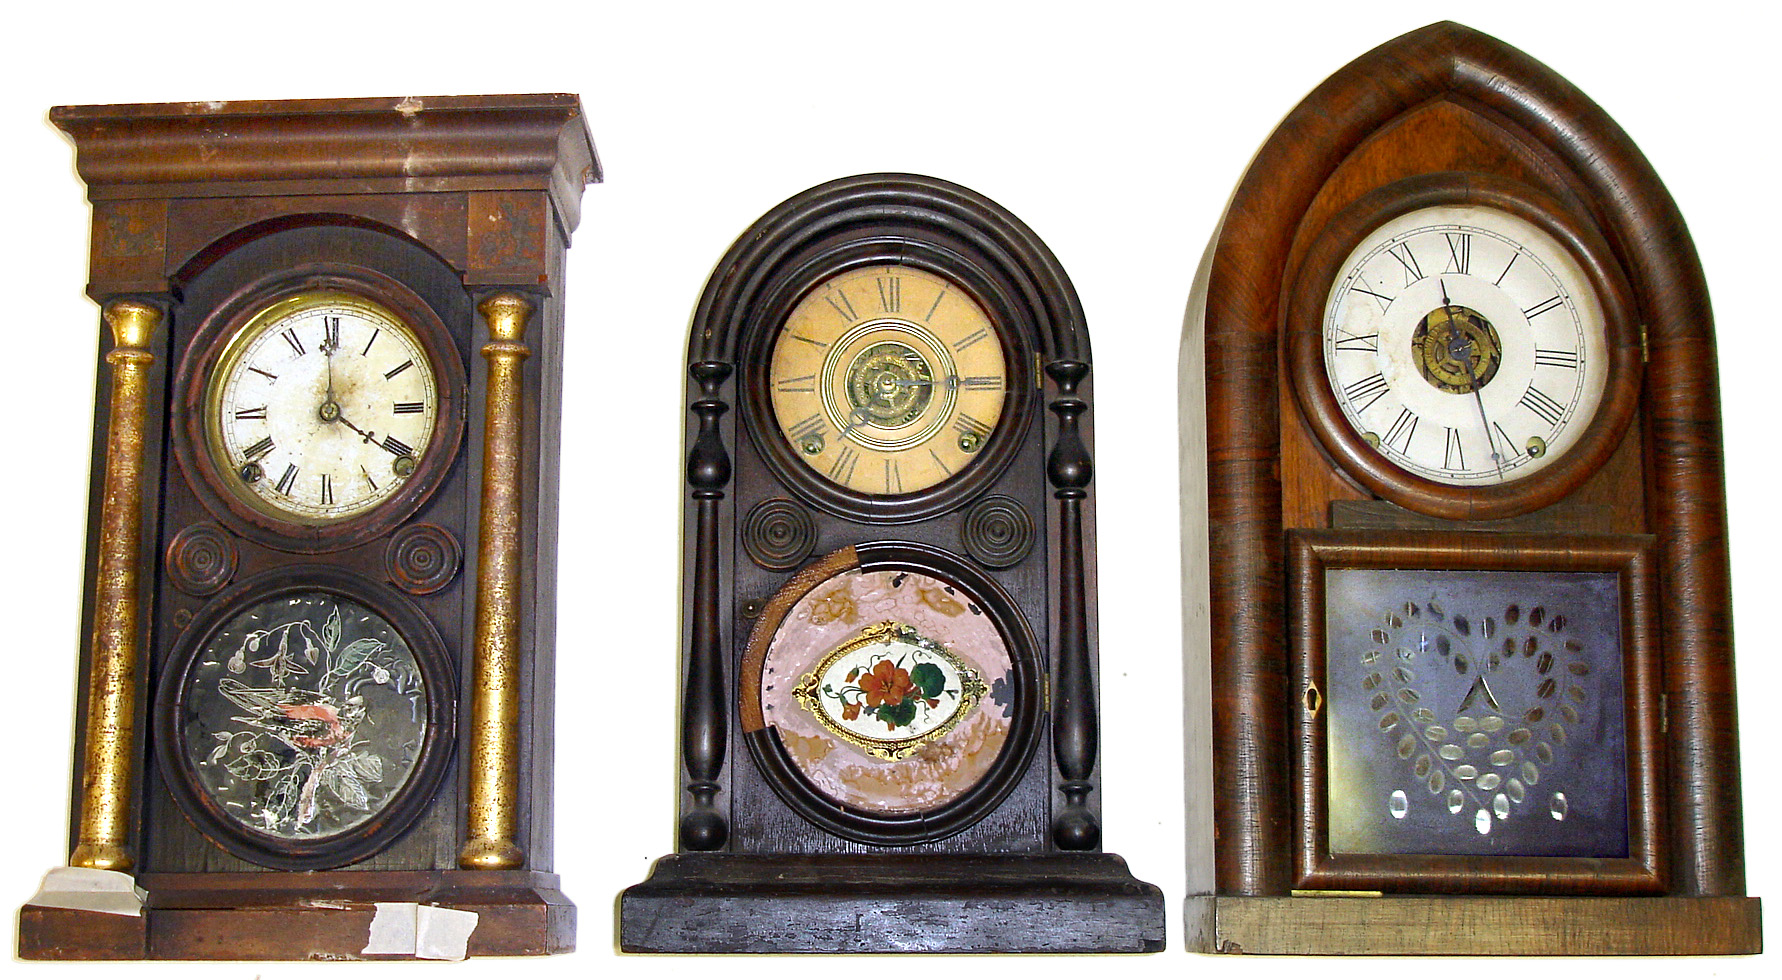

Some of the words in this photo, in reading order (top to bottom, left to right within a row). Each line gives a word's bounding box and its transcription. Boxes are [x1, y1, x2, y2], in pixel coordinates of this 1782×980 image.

[1383, 241, 1429, 289] XI
[1440, 233, 1472, 276] XII
[1492, 250, 1522, 288] I
[924, 290, 946, 324] I
[1347, 271, 1396, 315] X
[1520, 290, 1567, 326] II
[281, 327, 306, 361] XI
[321, 315, 341, 350] XII
[361, 327, 381, 357] I
[953, 327, 988, 353] II
[1335, 325, 1379, 356] IX
[383, 358, 414, 381] II
[1534, 343, 1577, 372] III
[965, 376, 1001, 390] III
[1342, 370, 1390, 419] VIII
[235, 404, 268, 422] IX
[393, 400, 424, 416] III
[1515, 379, 1568, 431] IIII
[382, 433, 413, 457] IIII
[1380, 404, 1419, 459] VII
[1441, 426, 1471, 471] VI
[1493, 421, 1526, 465] V
[274, 462, 300, 497] VII
[360, 464, 379, 493] V
[829, 444, 861, 486] VII
[884, 459, 903, 494] VI
[319, 473, 336, 505] VI
